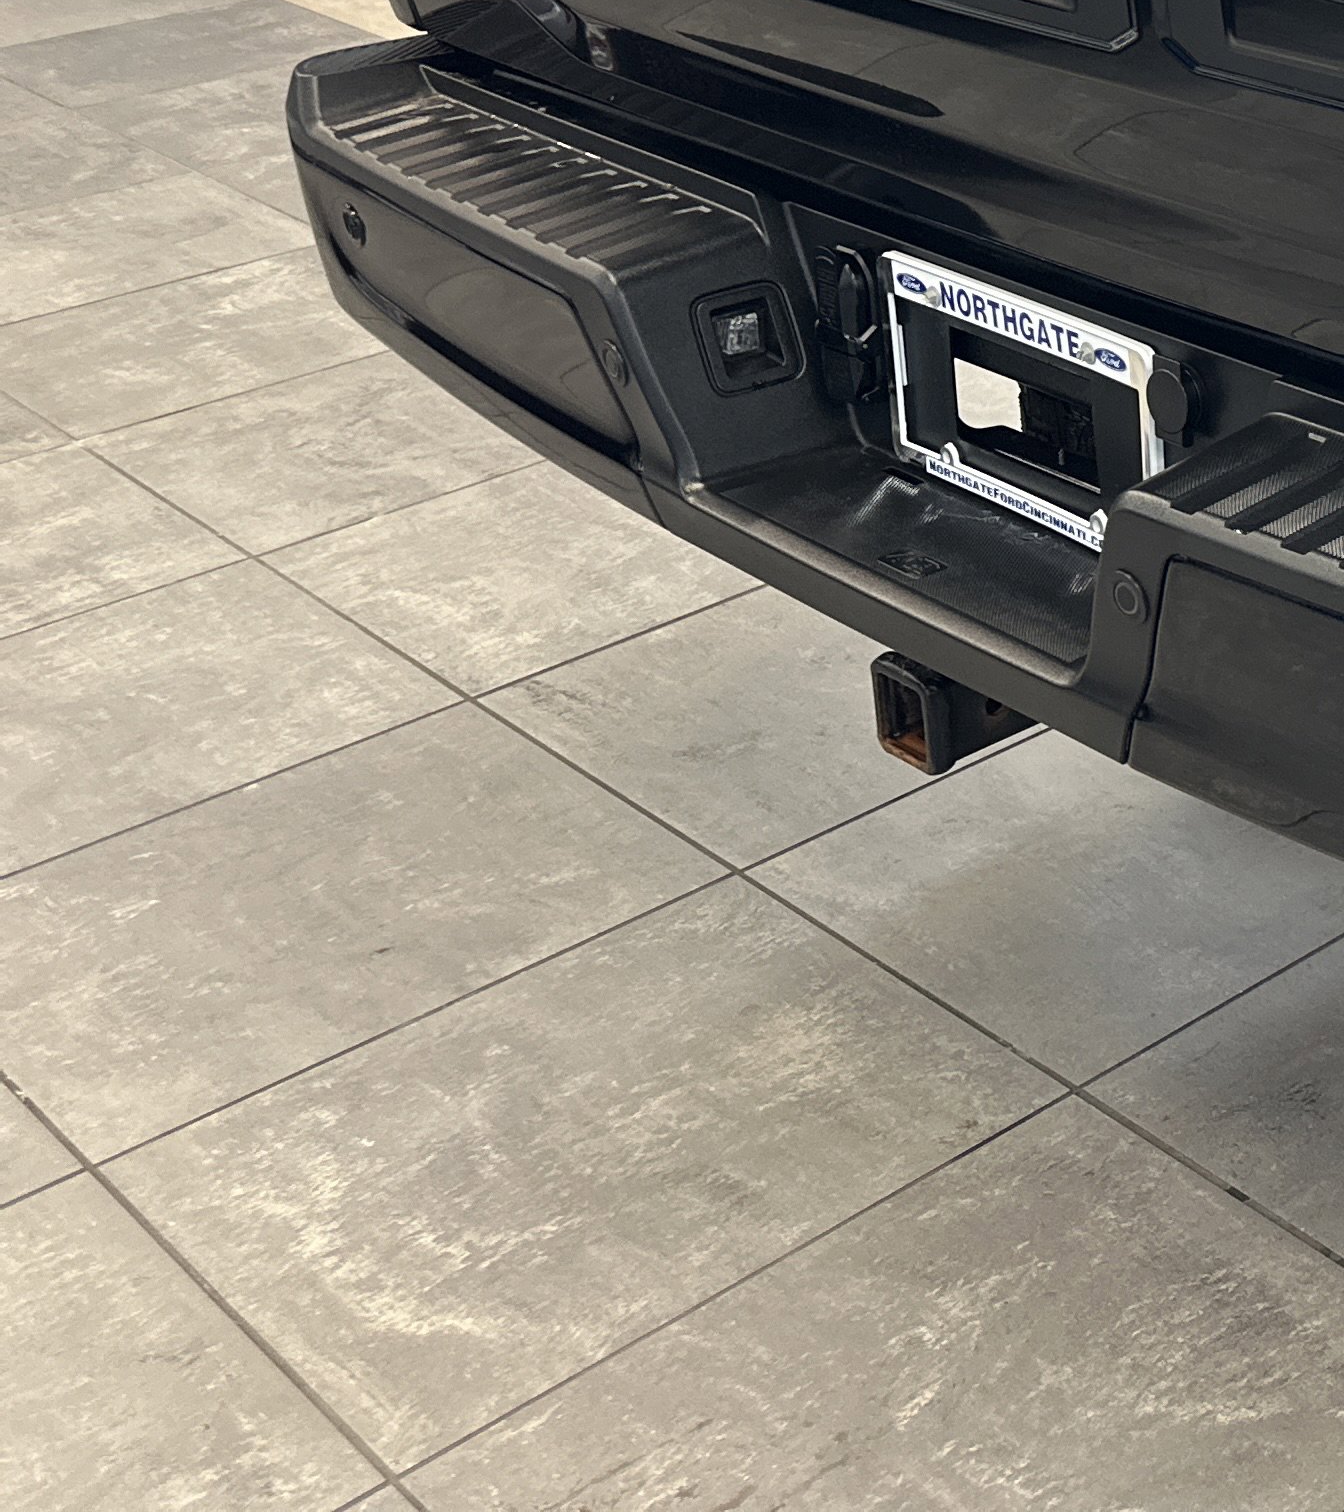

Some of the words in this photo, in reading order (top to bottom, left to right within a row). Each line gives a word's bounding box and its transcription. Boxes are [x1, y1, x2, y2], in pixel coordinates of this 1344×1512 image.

[899, 275, 923, 292] Ford
[939, 280, 1080, 358] NORTHGATE
[1099, 351, 1122, 369] Ford
